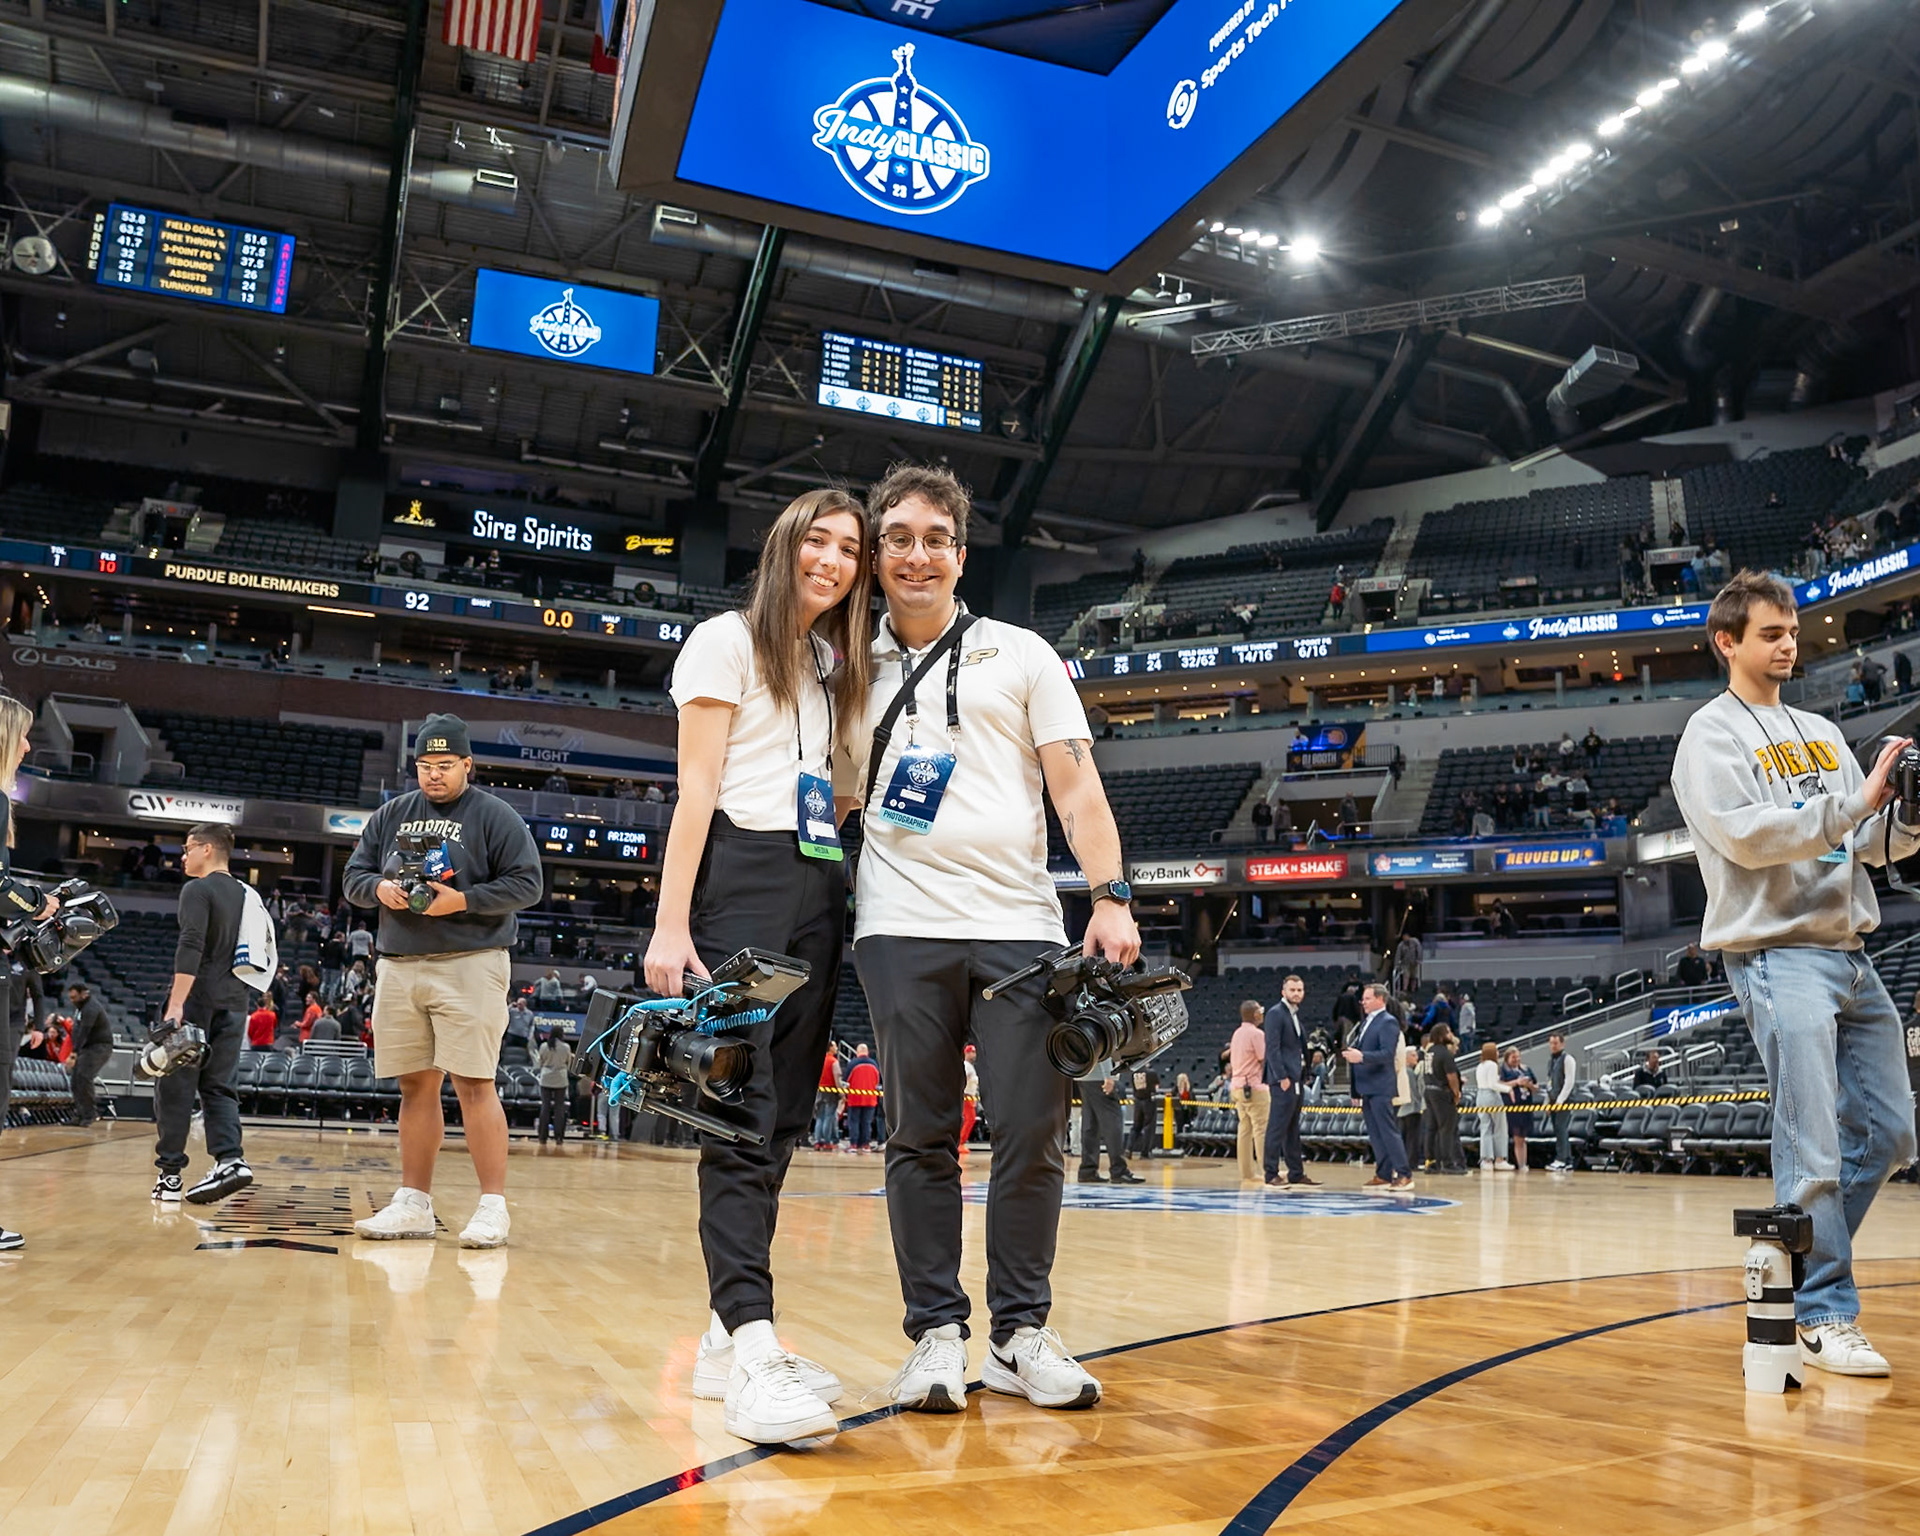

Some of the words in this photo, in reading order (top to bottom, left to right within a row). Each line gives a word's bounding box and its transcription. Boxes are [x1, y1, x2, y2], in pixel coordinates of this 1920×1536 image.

[1209, 8, 1244, 52] POWERED
[1201, 37, 1245, 89] Sports
[1245, 2, 1279, 43] Tech
[817, 108, 984, 174] IndyCLASSIC
[892, 184, 908, 199] 23
[121, 211, 145, 224] 53.8
[165, 219, 191, 232] FIELD
[191, 224, 216, 237] GOAL
[244, 233, 268, 246] 51.6
[88, 213, 104, 270] PURDUE
[119, 223, 144, 237] 63.2
[161, 231, 184, 243] FREE
[184, 235, 217, 249] THROW
[242, 245, 266, 258] 87.5
[117, 235, 142, 249] 41.7
[162, 243, 200, 258] 3-POINT
[199, 250, 212, 260] FG
[240, 256, 265, 269] 37.5
[120, 248, 135, 260] 32
[165, 256, 215, 272] REBOUNDS
[243, 269, 258, 280] 26
[118, 260, 133, 271] 22
[168, 269, 207, 283] ASSISTS
[242, 281, 256, 292] 24
[274, 242, 291, 305] ARIZONA
[118, 271, 131, 283] 13
[159, 279, 213, 296] TURNOVERS
[241, 292, 254, 304] 13
[913, 360, 939, 370] BRADLEY
[913, 368, 928, 377] LOVE
[473, 510, 517, 542] Sire
[523, 516, 593, 552] Spirits
[53, 554, 60, 567] 1
[99, 560, 117, 573] 10
[164, 564, 227, 585] PURDUE
[227, 572, 340, 598] BOILERMAKERS
[1828, 550, 1909, 597] IndyCLASSIC
[405, 592, 430, 611] 92
[543, 609, 574, 628] 0.0
[601, 614, 621, 624] HALF
[1528, 613, 1618, 640] IndyCLASSIC
[605, 623, 615, 635] 2
[658, 622, 683, 643] 84
[960, 648, 999, 667] P
[1237, 650, 1274, 664] 14/16
[1298, 644, 1328, 659] 6/16
[42, 654, 117, 671] LEXUS
[1113, 662, 1130, 675] 26
[1146, 659, 1162, 672] 24
[1180, 655, 1217, 669] 32/62
[521, 747, 570, 763] FLIGHT
[1311, 752, 1337, 762] BOOTH
[176, 799, 204, 808] CITY
[210, 803, 241, 812] WIDE
[883, 809, 929, 830] PHOTOGRAPHER
[607, 831, 646, 844] ARIZONA
[566, 843, 574, 853] 2
[622, 845, 638, 857] 84
[1506, 850, 1559, 866] REVVED
[1560, 849, 1580, 862] UP
[1132, 866, 1191, 882] KeyBank
[1249, 863, 1289, 877] STEAK
[1299, 860, 1343, 874] SHAKE
